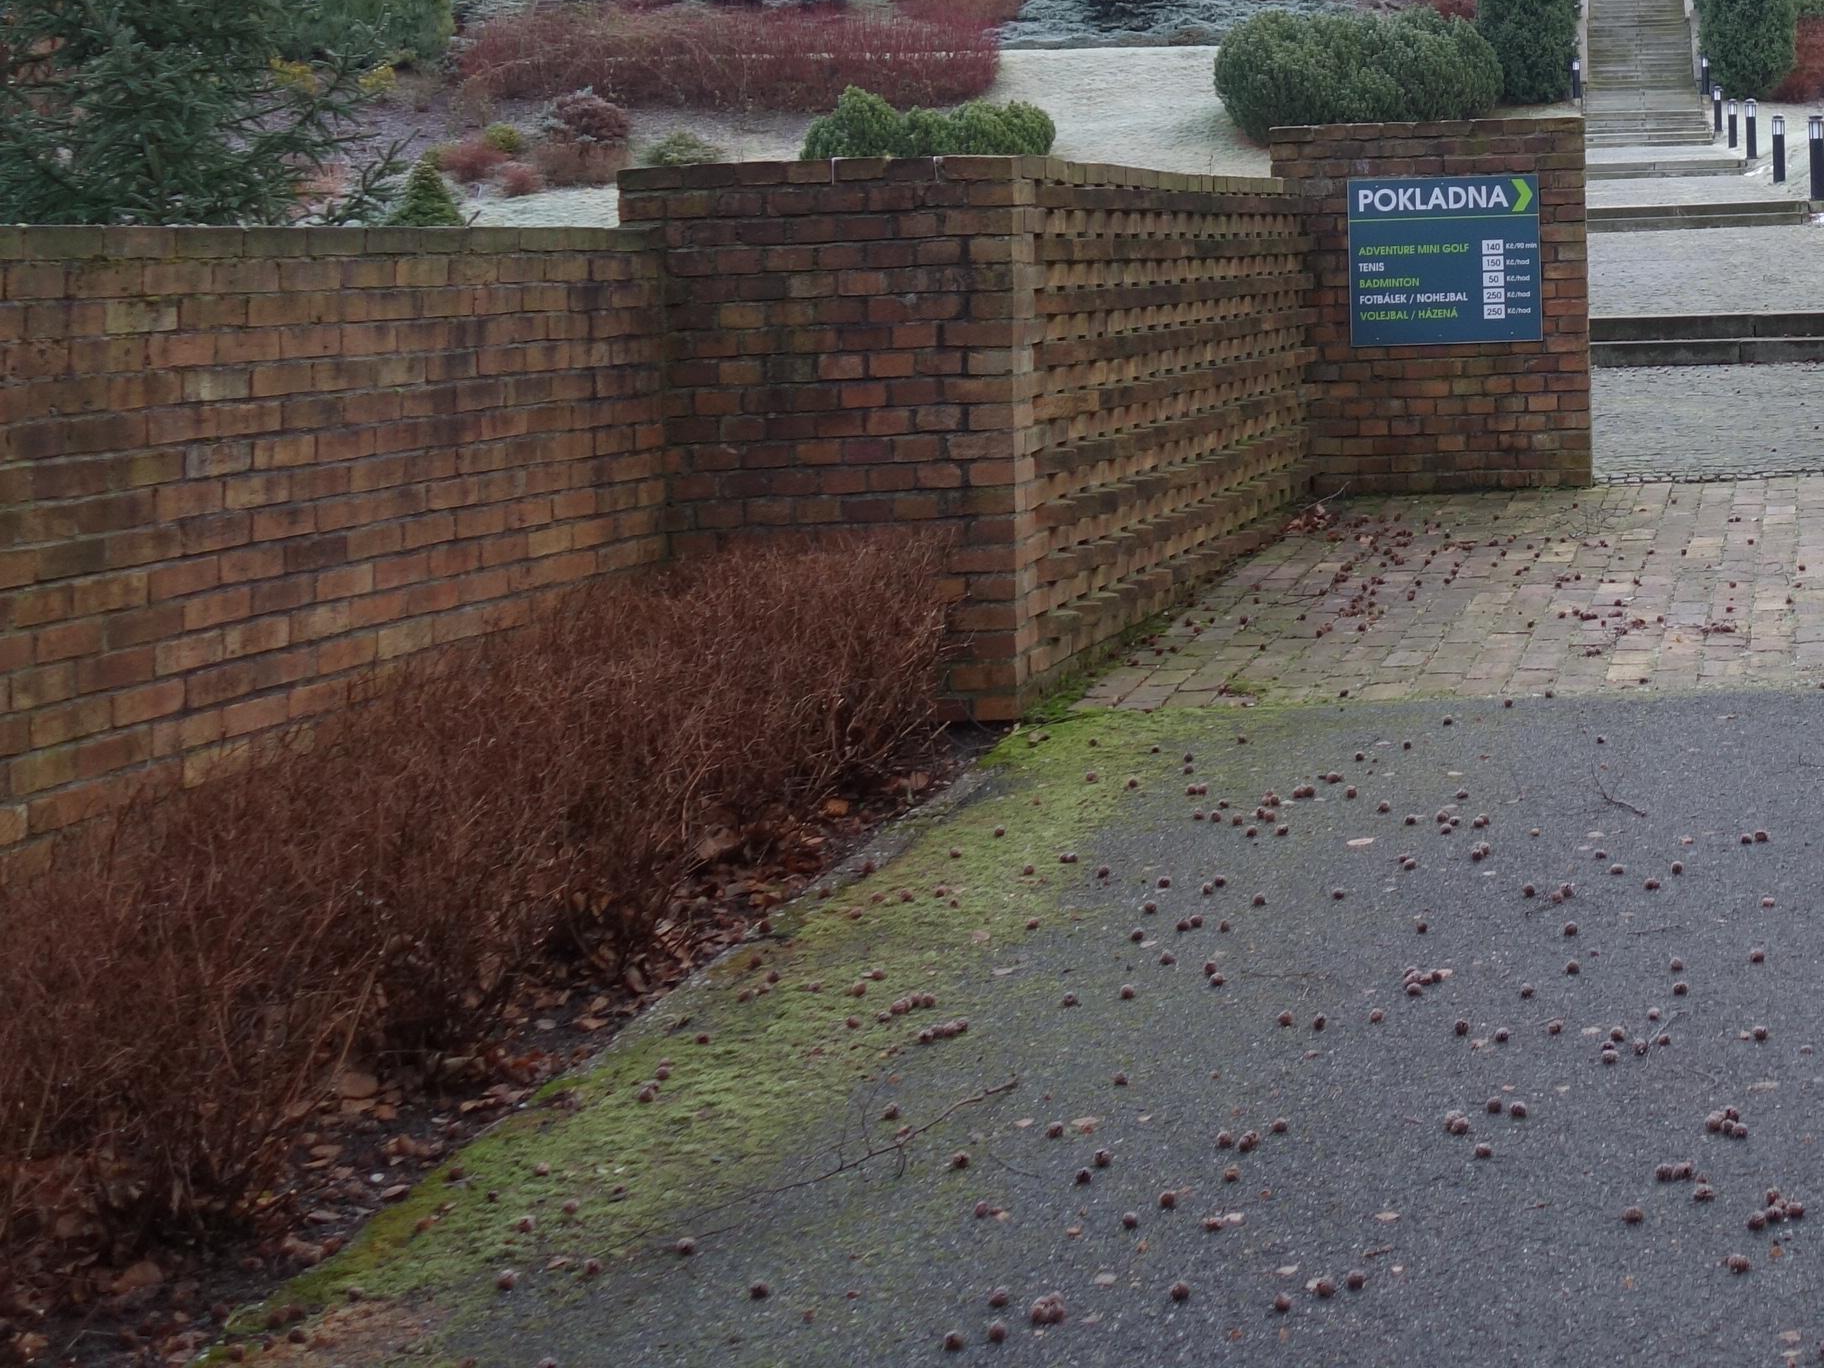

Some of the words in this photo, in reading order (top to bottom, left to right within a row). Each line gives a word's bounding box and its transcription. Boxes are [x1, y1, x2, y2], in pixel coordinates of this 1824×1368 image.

[1358, 185, 1509, 212] POKLADNA
[1358, 245, 1415, 256] ADVENTURE
[1417, 244, 1440, 254] MINI
[1442, 243, 1469, 253] GOLF
[1486, 243, 1500, 251] 140
[1358, 262, 1385, 272] TENIS
[1486, 259, 1500, 267] 150
[1360, 277, 1420, 288] BADMINTON
[1488, 275, 1499, 283] 50
[1360, 292, 1407, 304] FOTBÁLEK
[1416, 292, 1468, 303] NOHEJBAL
[1486, 292, 1502, 300] 250
[1360, 310, 1409, 320] VOLEJBAL
[1418, 306, 1459, 319] HÁZENÁ
[1487, 308, 1503, 316] 250
